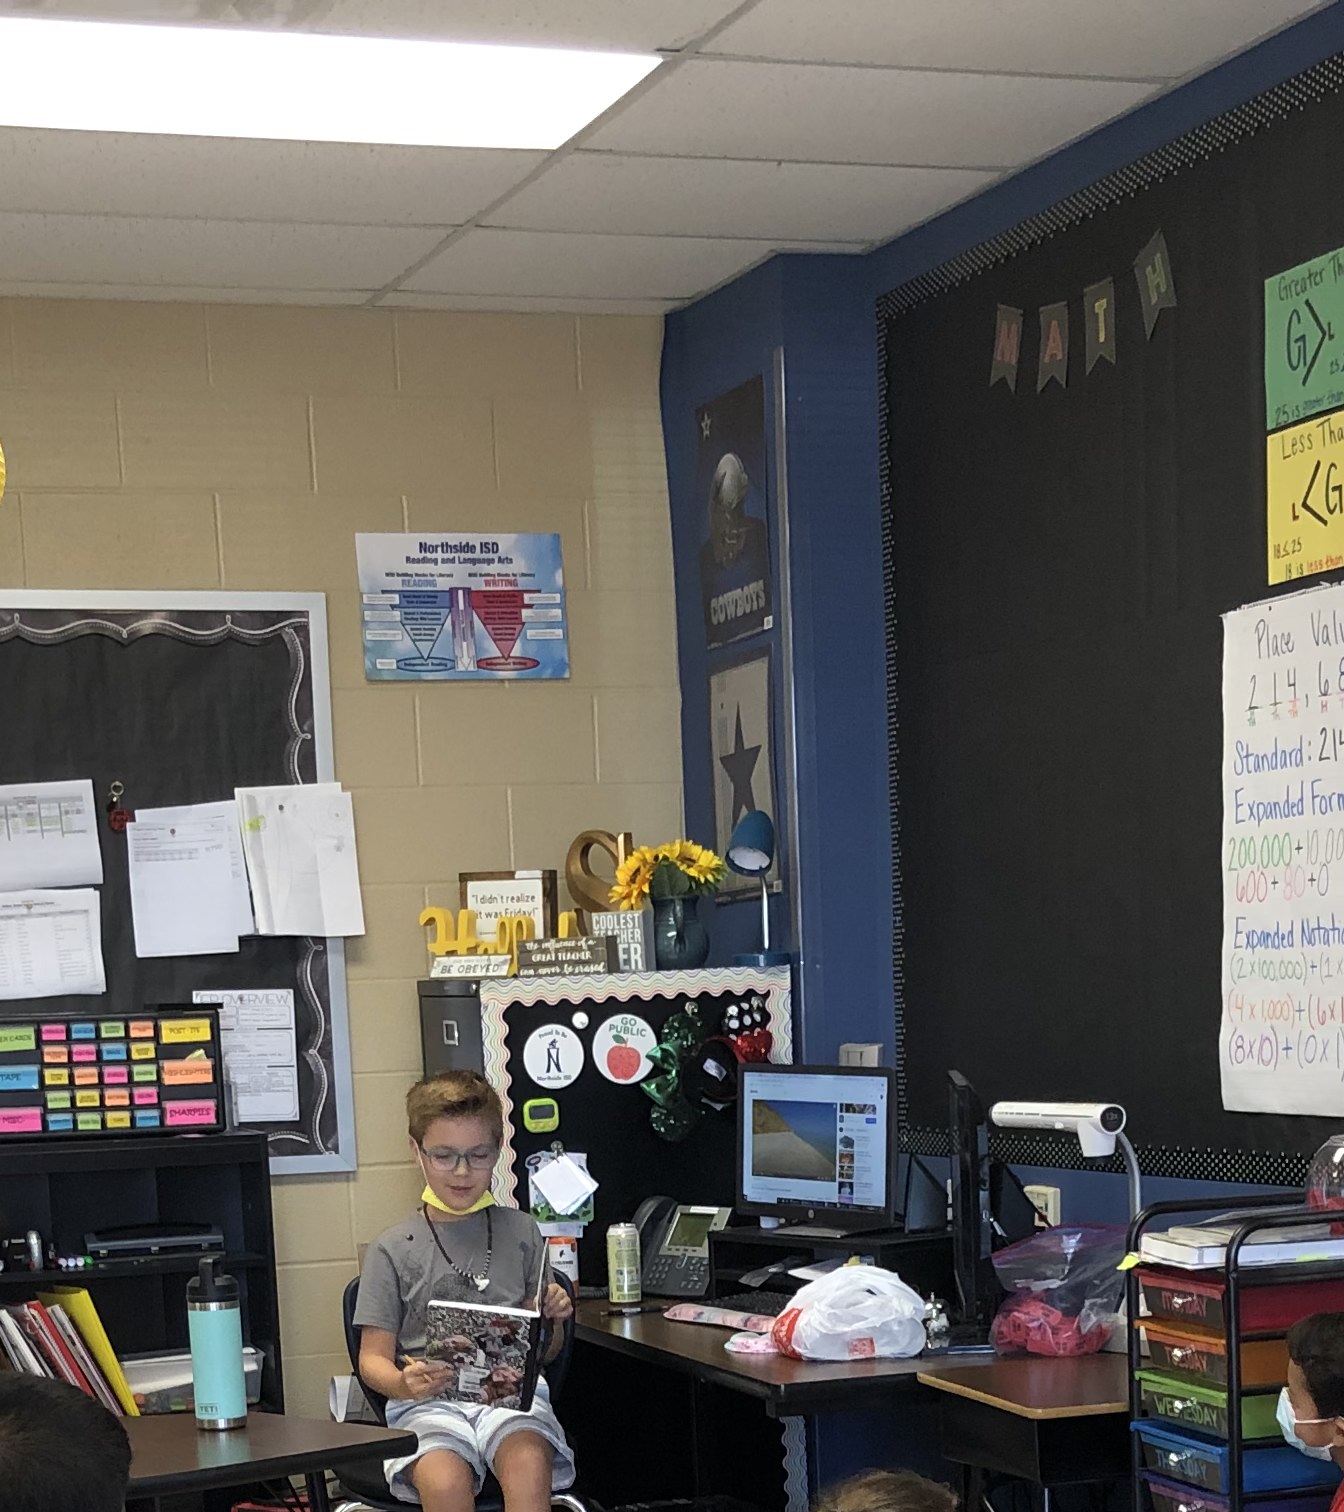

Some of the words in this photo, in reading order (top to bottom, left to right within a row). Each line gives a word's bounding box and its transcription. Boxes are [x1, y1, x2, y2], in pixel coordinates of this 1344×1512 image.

[1279, 268, 1325, 301] Greater
[1281, 432, 1314, 461] Less
[419, 541, 477, 554] Northside
[479, 541, 500, 554] ISD
[406, 556, 439, 567] Reading
[440, 556, 456, 565] and
[457, 556, 496, 567] Language
[497, 556, 514, 565] Arts
[401, 579, 438, 589] READING
[483, 579, 520, 589] WRITING
[710, 579, 766, 626] COWBOYS
[1255, 618, 1295, 660] Place
[1234, 780, 1305, 828] Expanded
[1235, 870, 1268, 903] 600
[505, 892, 536, 903] realize
[592, 913, 640, 930] COOLEST
[1234, 917, 1295, 956] Expanded
[531, 952, 556, 963] GREAT
[441, 964, 452, 975] BE
[455, 963, 500, 975] OBEYED
[222, 993, 289, 1006] OVERVIEW
[620, 1016, 637, 1027] GO
[608, 1023, 647, 1037] PUBLIC
[168, 1107, 213, 1118] SHARPIES
[197, 1404, 219, 1415] YETI
